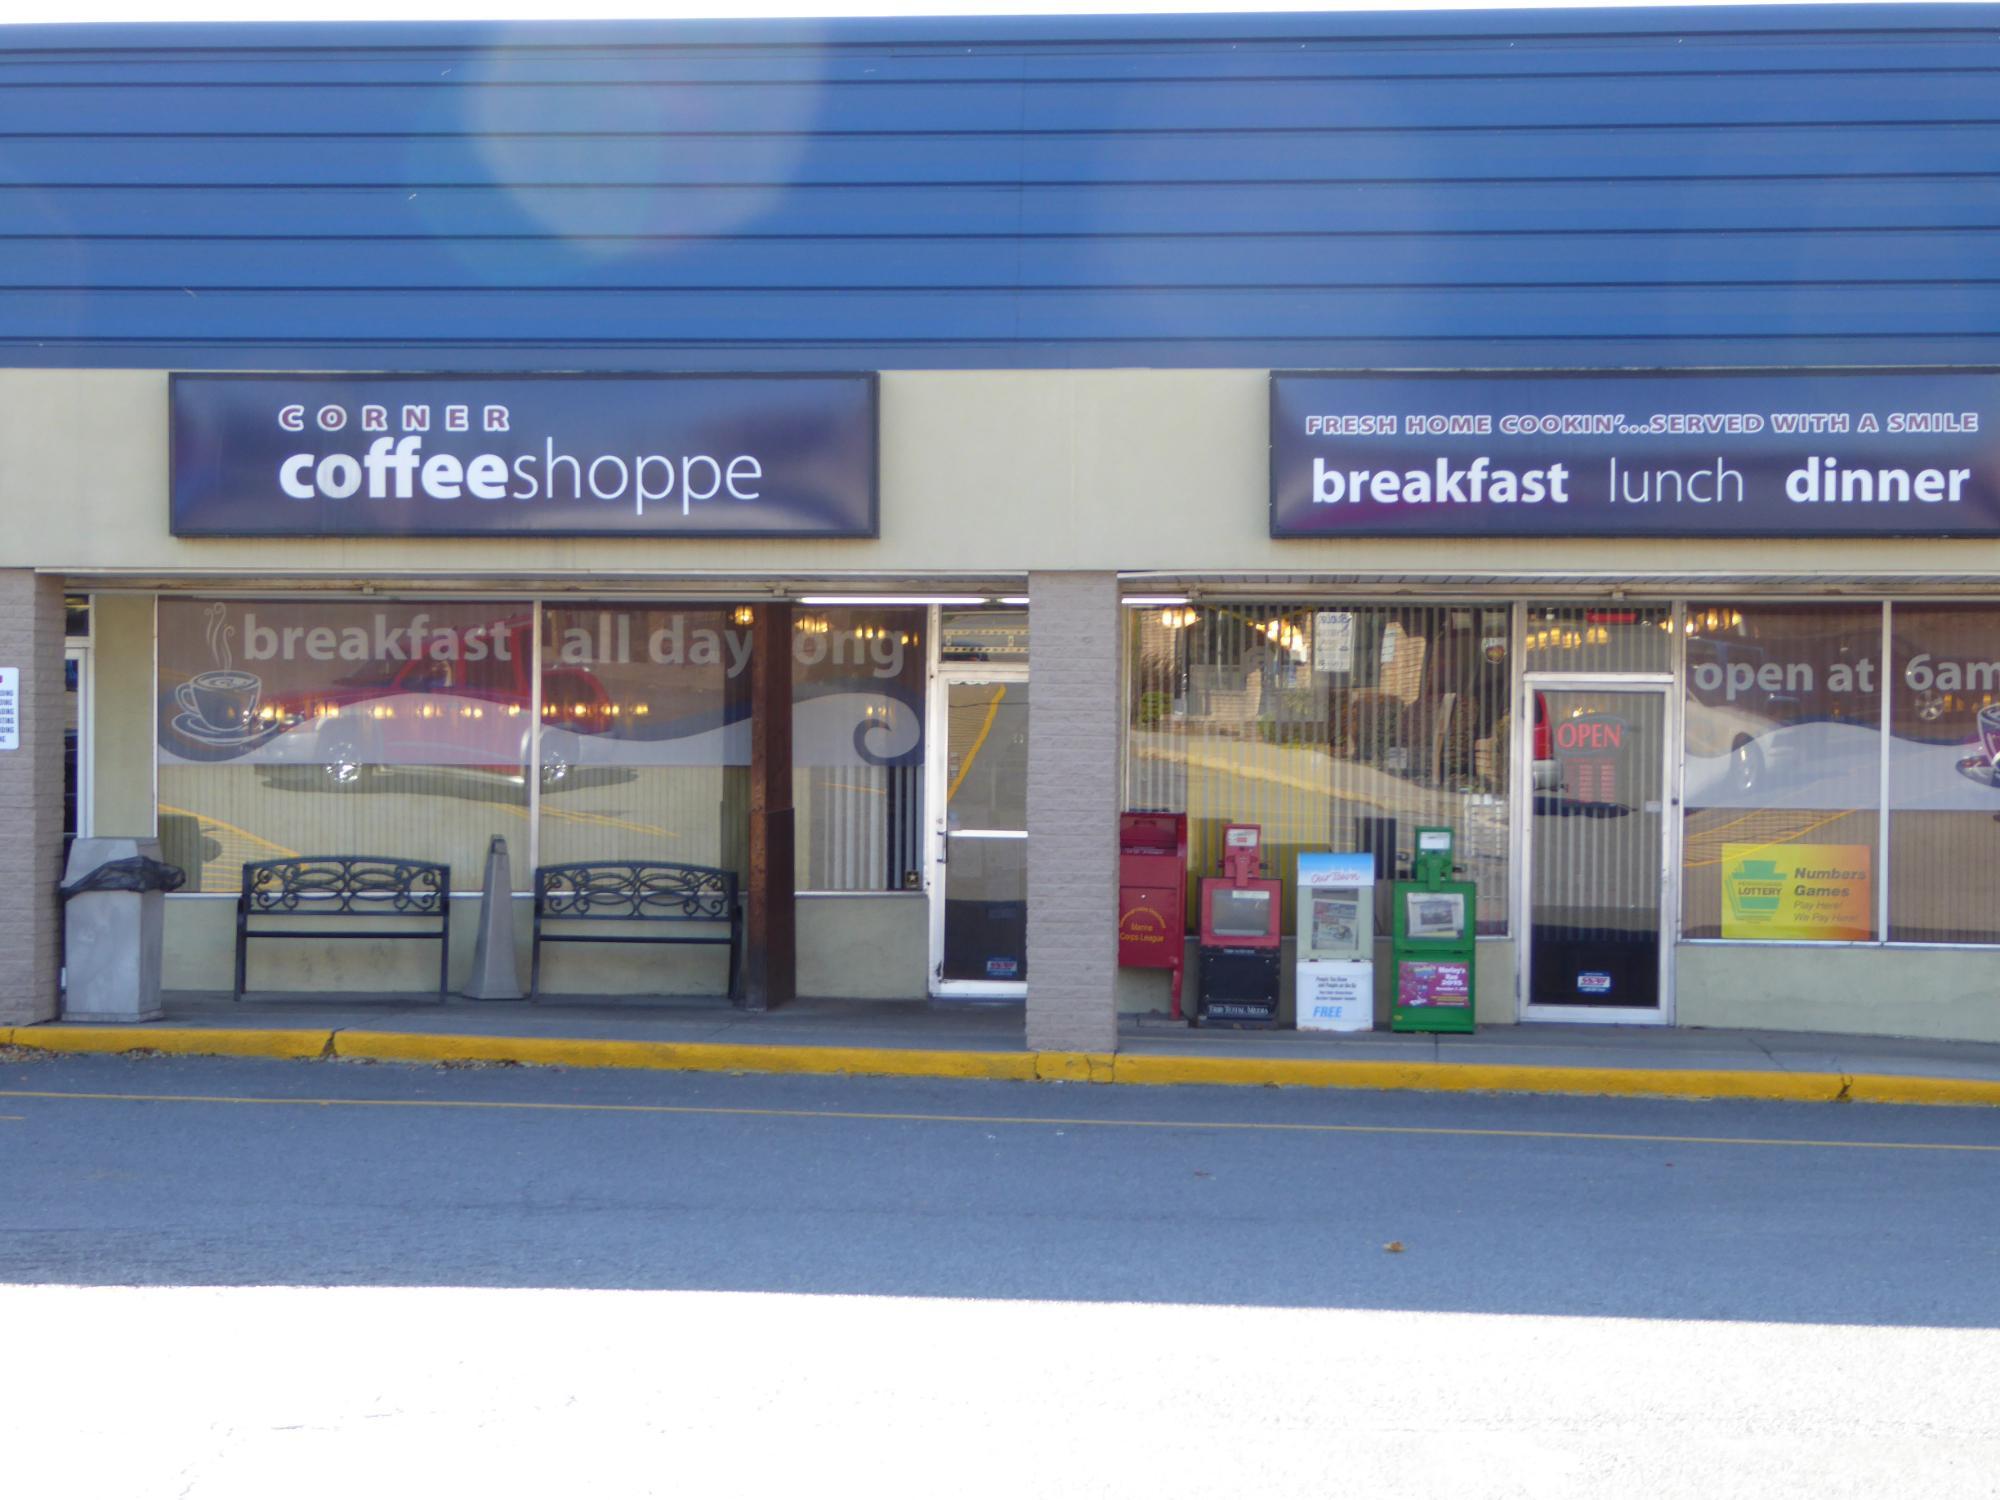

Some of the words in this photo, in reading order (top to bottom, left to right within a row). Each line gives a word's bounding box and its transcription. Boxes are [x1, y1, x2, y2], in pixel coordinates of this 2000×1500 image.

[278, 405, 510, 431] CORNER
[1305, 415, 1397, 434] FRESH
[1405, 415, 1491, 434] HOME
[1771, 413, 1850, 433] WITH
[1857, 413, 1879, 432] A
[1887, 413, 1979, 432] SMILE
[1313, 457, 1568, 503] breakfast
[1610, 457, 1743, 502] lunch
[1785, 457, 1970, 502] dinner
[244, 614, 512, 661] breakfast
[561, 613, 630, 665] all
[649, 614, 753, 678] day
[792, 628, 905, 678] ong
[1695, 661, 1813, 701] open
[1827, 658, 1875, 692] at
[1906, 653, 2000, 691] 6am
[1557, 722, 1622, 749] OPEN
[1794, 867, 1866, 880] Numbers
[1738, 887, 1783, 896] LOTTERY
[1794, 885, 1850, 897] Games
[1793, 900, 1813, 910] Play
[1794, 913, 1809, 922] We
[1812, 913, 1829, 923] Pay
[1313, 1006, 1343, 1017] FREE
